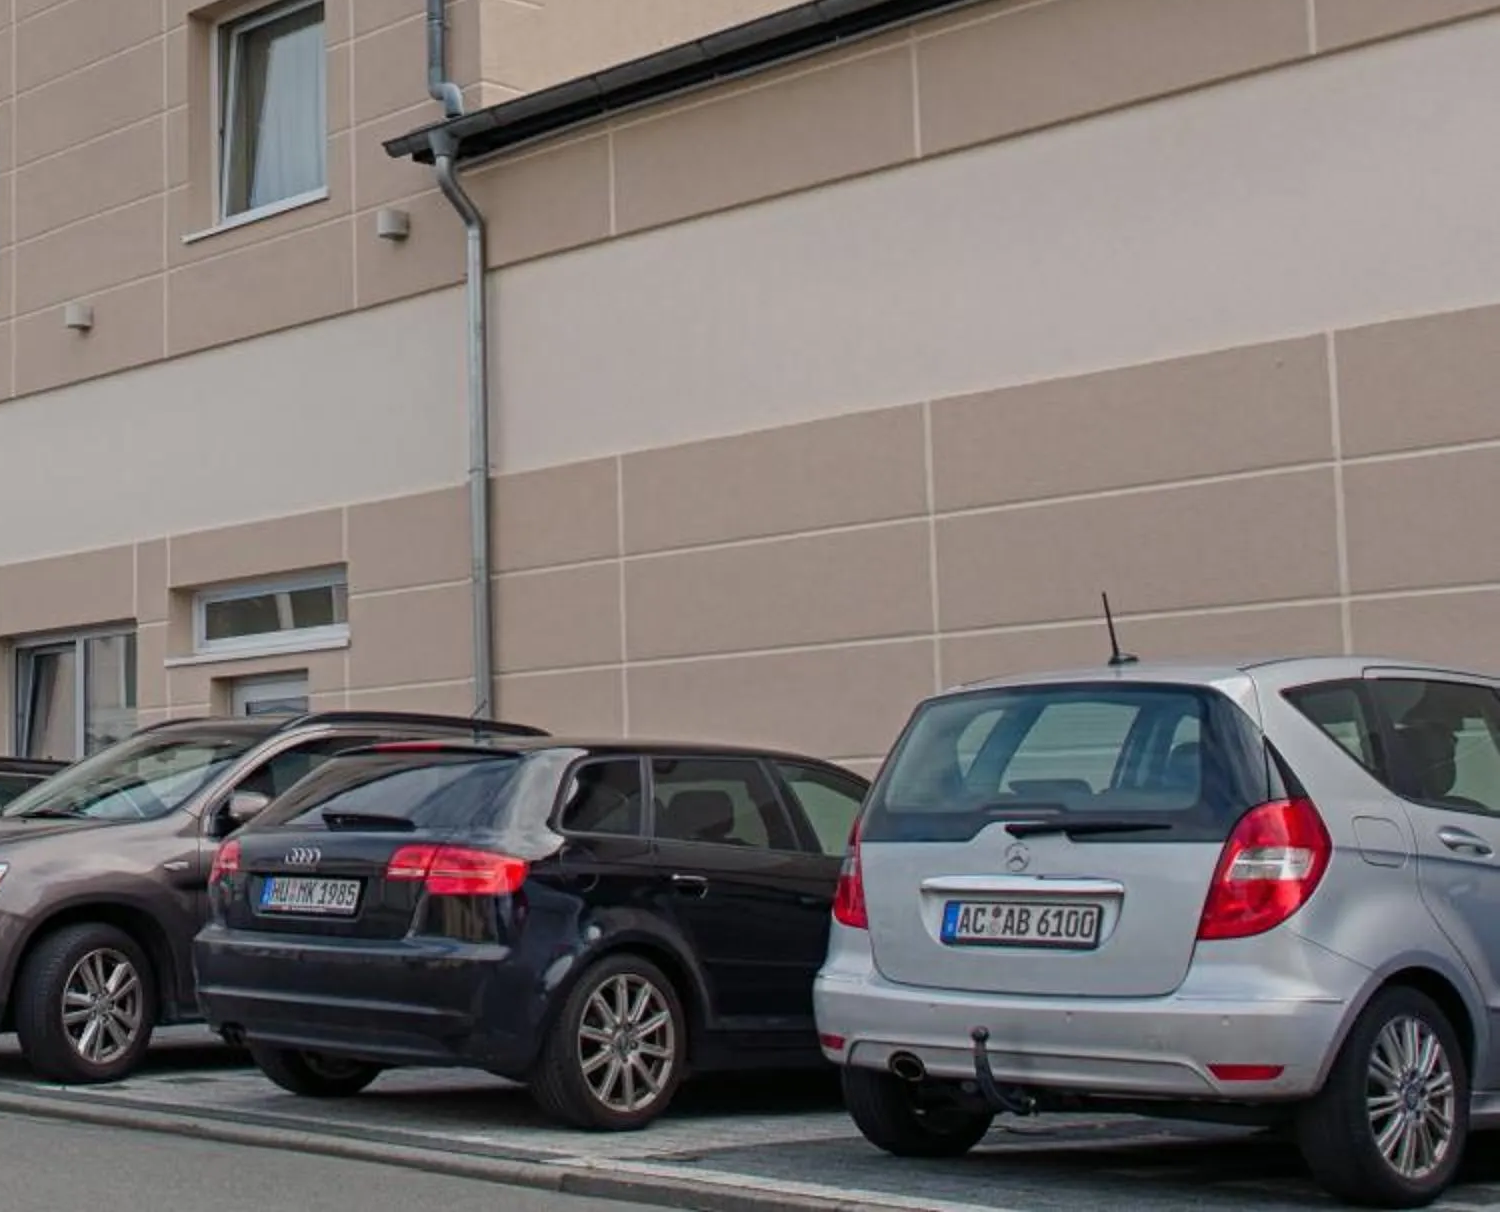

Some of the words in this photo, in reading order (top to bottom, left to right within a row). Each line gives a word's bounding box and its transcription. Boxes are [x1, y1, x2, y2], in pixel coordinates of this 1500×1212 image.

[317, 881, 357, 907] 1985
[957, 906, 987, 934] AC
[1002, 907, 1032, 936] AB
[1036, 909, 1095, 938] 6100
